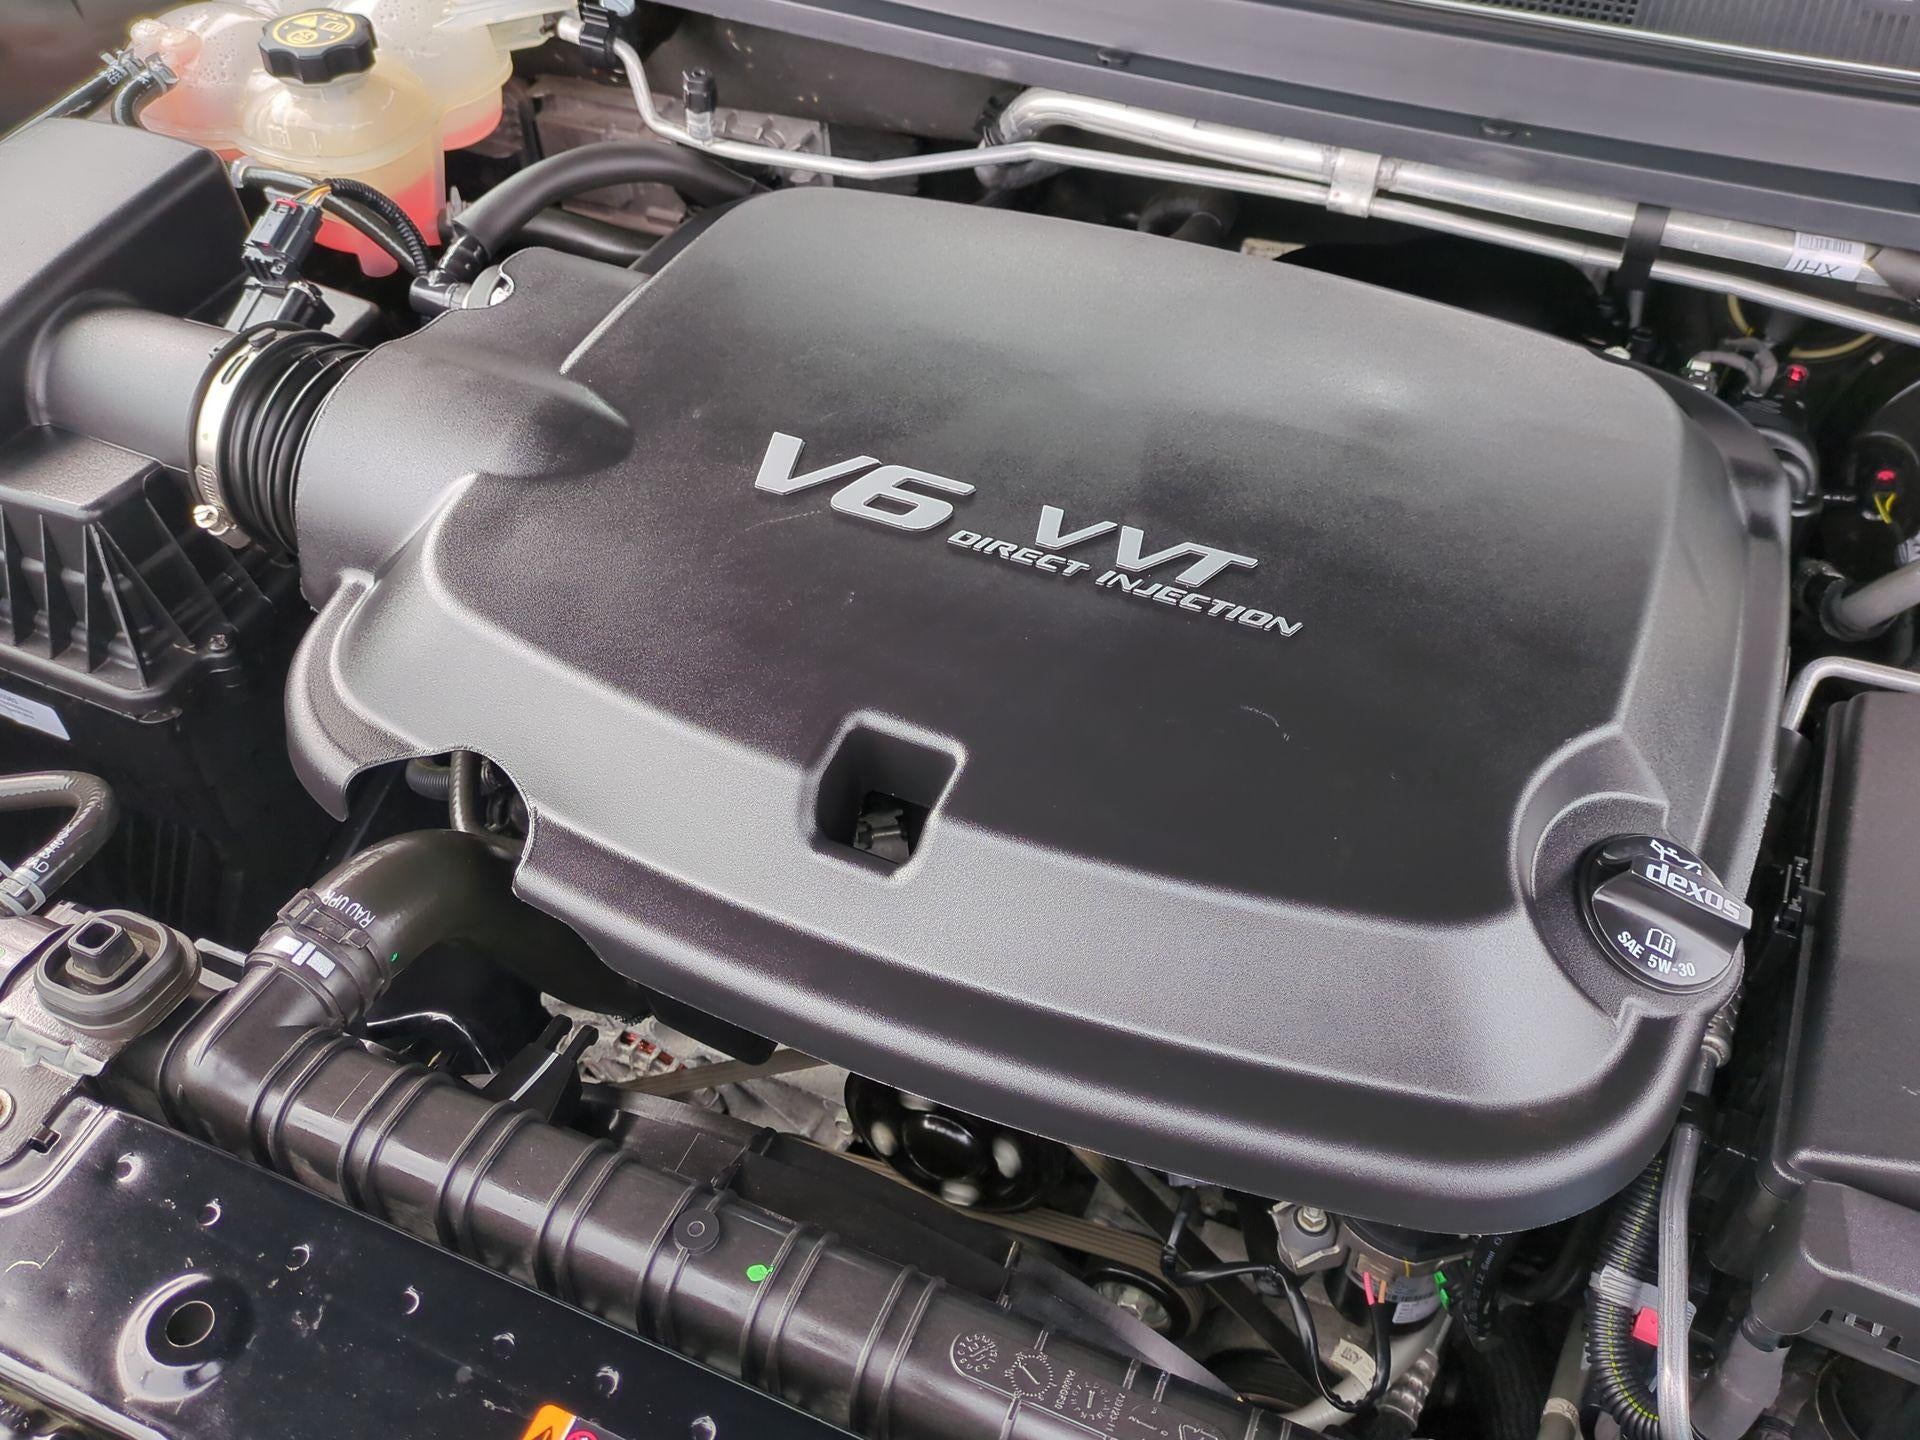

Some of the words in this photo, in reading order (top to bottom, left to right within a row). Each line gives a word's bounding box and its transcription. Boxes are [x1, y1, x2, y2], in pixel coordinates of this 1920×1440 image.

[755, 431, 976, 532] V6
[1035, 504, 1258, 588] VVT
[947, 529, 1091, 577] DIRECT
[1096, 570, 1303, 638] INJECTION
[320, 889, 350, 911] UPR
[345, 902, 377, 929] RAD
[1645, 863, 1741, 921] dexos
[1617, 930, 1645, 959] SAE
[1647, 954, 1696, 977] 5W-30
